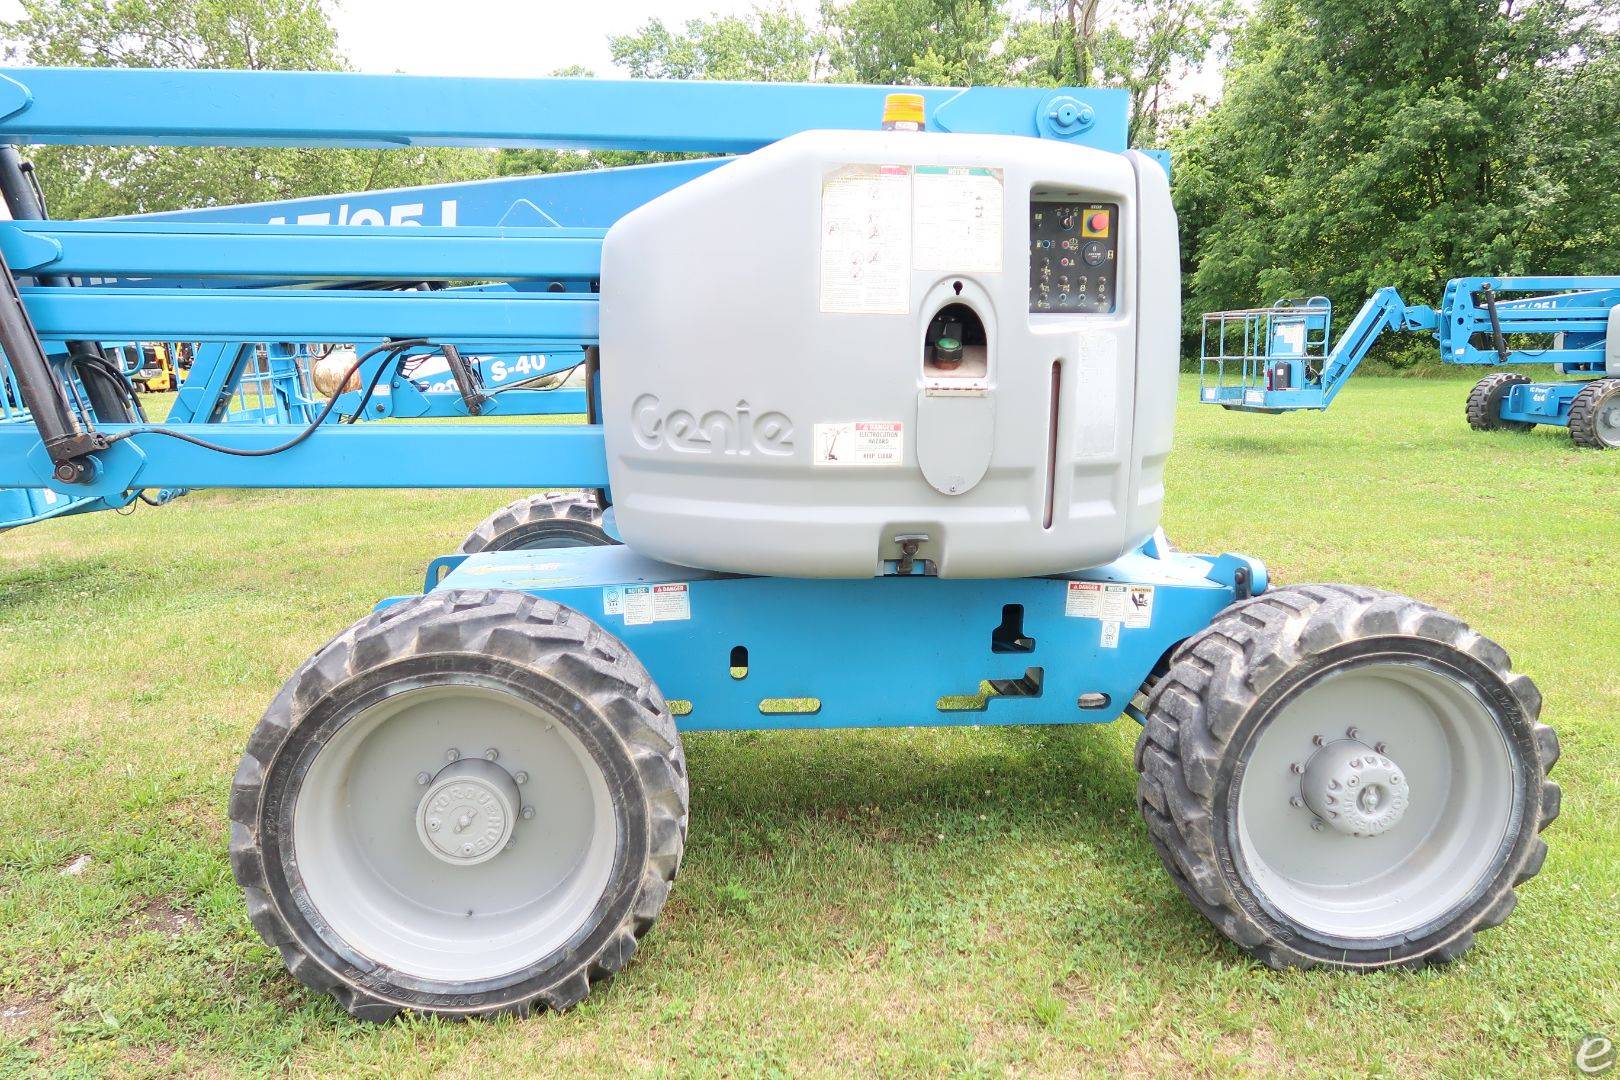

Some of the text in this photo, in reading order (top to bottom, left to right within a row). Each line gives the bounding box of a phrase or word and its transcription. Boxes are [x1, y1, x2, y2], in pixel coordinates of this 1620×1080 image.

[491, 354, 547, 382] S-40
[631, 393, 795, 456] Genie
[663, 584, 684, 592] DANGER
